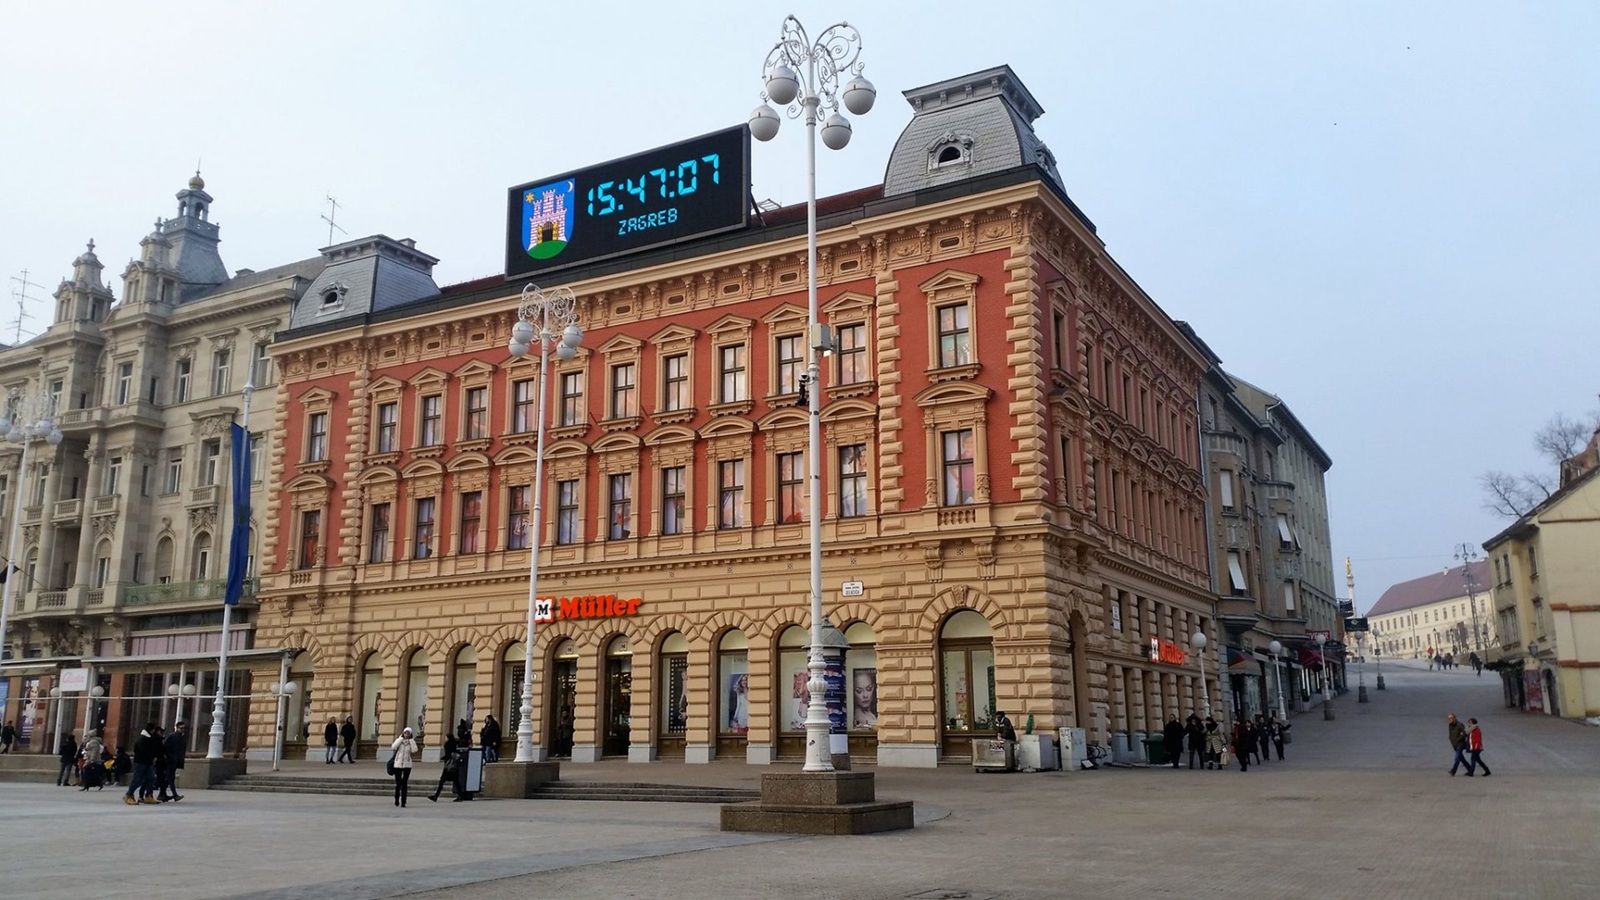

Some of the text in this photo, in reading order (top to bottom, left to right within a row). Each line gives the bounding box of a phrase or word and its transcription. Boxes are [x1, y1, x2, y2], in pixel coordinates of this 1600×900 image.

[588, 153, 719, 216] 15:47:07
[617, 208, 678, 235] ZAGREB
[538, 594, 641, 619] M Müller
